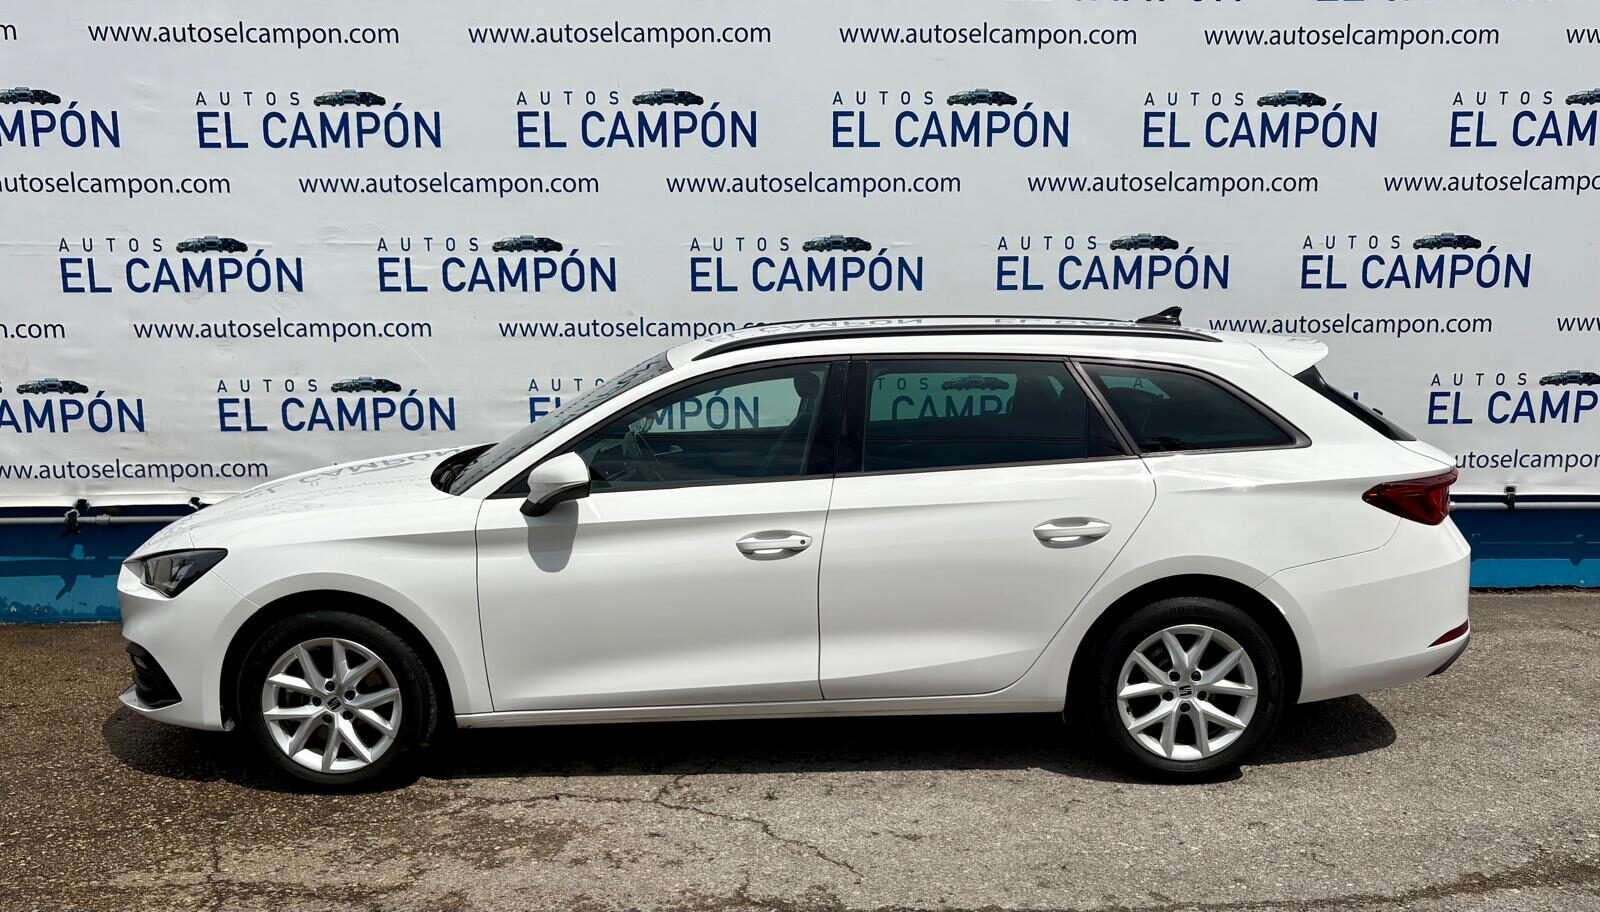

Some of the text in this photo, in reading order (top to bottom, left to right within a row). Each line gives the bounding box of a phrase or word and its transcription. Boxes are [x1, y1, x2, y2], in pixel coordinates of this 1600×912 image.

[87, 20, 400, 50] www.autoselcampon.com
[467, 20, 771, 49] www.autoselcampon.com
[839, 21, 1137, 50] www.autoselcampon.com
[1203, 23, 1500, 51] www.autoselcampon.com
[195, 91, 300, 107] AUTOS
[516, 90, 619, 106] AUTOS
[832, 90, 934, 106] AUTOS
[1143, 91, 1244, 107] AUTOS
[1452, 90, 1553, 106] AUTOS
[0, 100, 121, 148] MPÓN
[196, 101, 442, 149] EL CAMPÓN
[517, 101, 757, 149] EL CAMPÓN
[832, 101, 1069, 148] EL CAMPÓN
[1142, 101, 1378, 149] EL CAMPÓN
[1449, 109, 1598, 148] EL CAM
[0, 171, 231, 199] utoselcampon.com
[298, 171, 599, 199] www.autoselcampon.com
[665, 170, 961, 199] www.autoselcampon.com
[1027, 170, 1318, 198] www.autoselcampon.com
[58, 237, 163, 253] AUTOS
[377, 237, 479, 252] AUTOS
[689, 236, 790, 252] AUTOS
[997, 235, 1097, 251] AUTOS
[1302, 234, 1401, 250] AUTOS
[59, 247, 304, 294] EL CAMPÓN
[377, 247, 617, 293] EL CAMPÓN
[690, 247, 923, 293] EL CAMPÓN
[996, 247, 1230, 291] EL CAMPÓN
[1300, 247, 1532, 290] EL CAMPÓN
[133, 316, 432, 343] www.autoselcampon.com
[1208, 311, 1493, 337] www.autoselcampon.com
[216, 378, 318, 393] AUTOS
[1430, 372, 1527, 387] AUTOS
[0, 390, 146, 434] AMPÓN
[217, 389, 456, 433] EL CAMPÓN
[1427, 390, 1599, 425] EL CAMP
